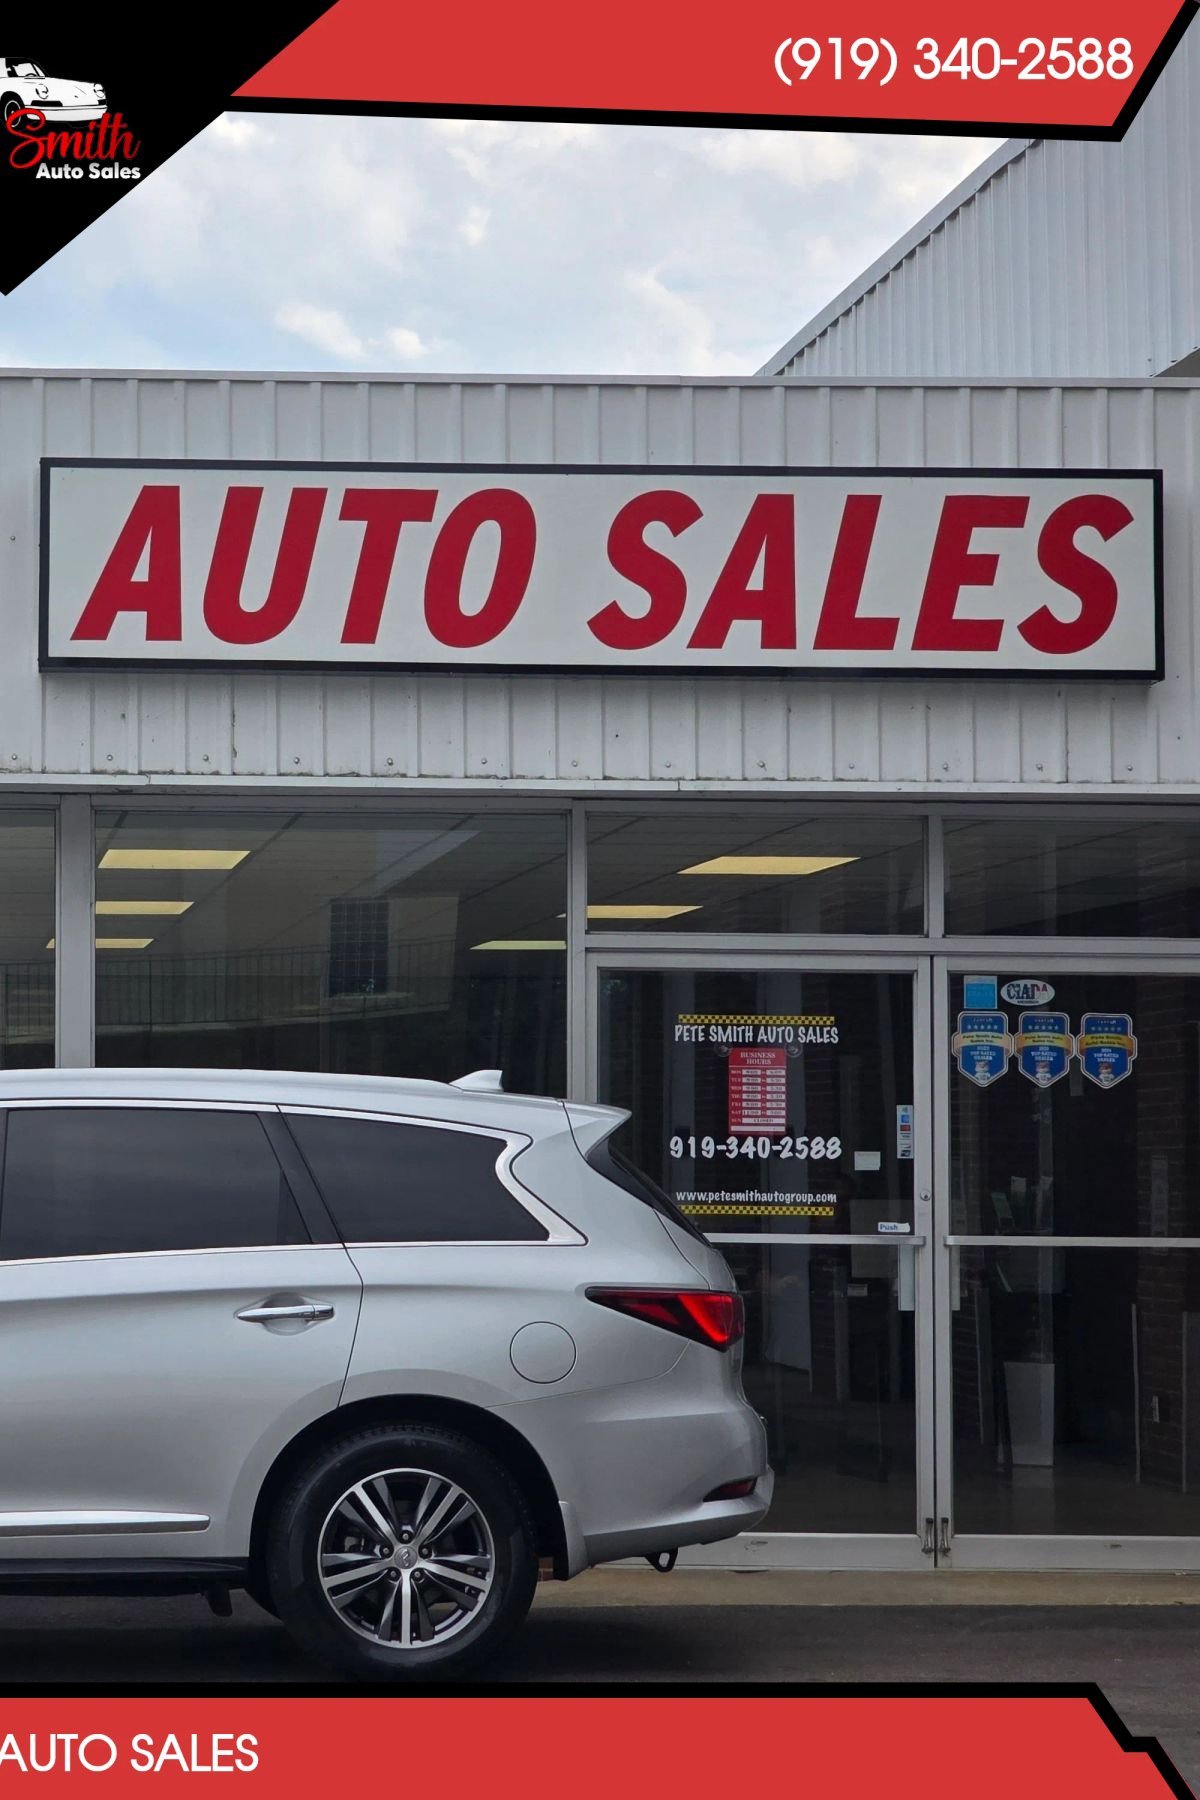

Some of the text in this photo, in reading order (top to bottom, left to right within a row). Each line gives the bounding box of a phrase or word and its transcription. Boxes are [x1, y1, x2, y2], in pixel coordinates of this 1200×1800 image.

[69, 484, 1135, 654] AUTO SALES
[674, 1024, 839, 1044] PETE SMITH AUTO SALES
[669, 1136, 842, 1160] 919-340-2588
[676, 1190, 837, 1204] www.petesmithautogroup.com
[880, 1223, 898, 1231] Push
